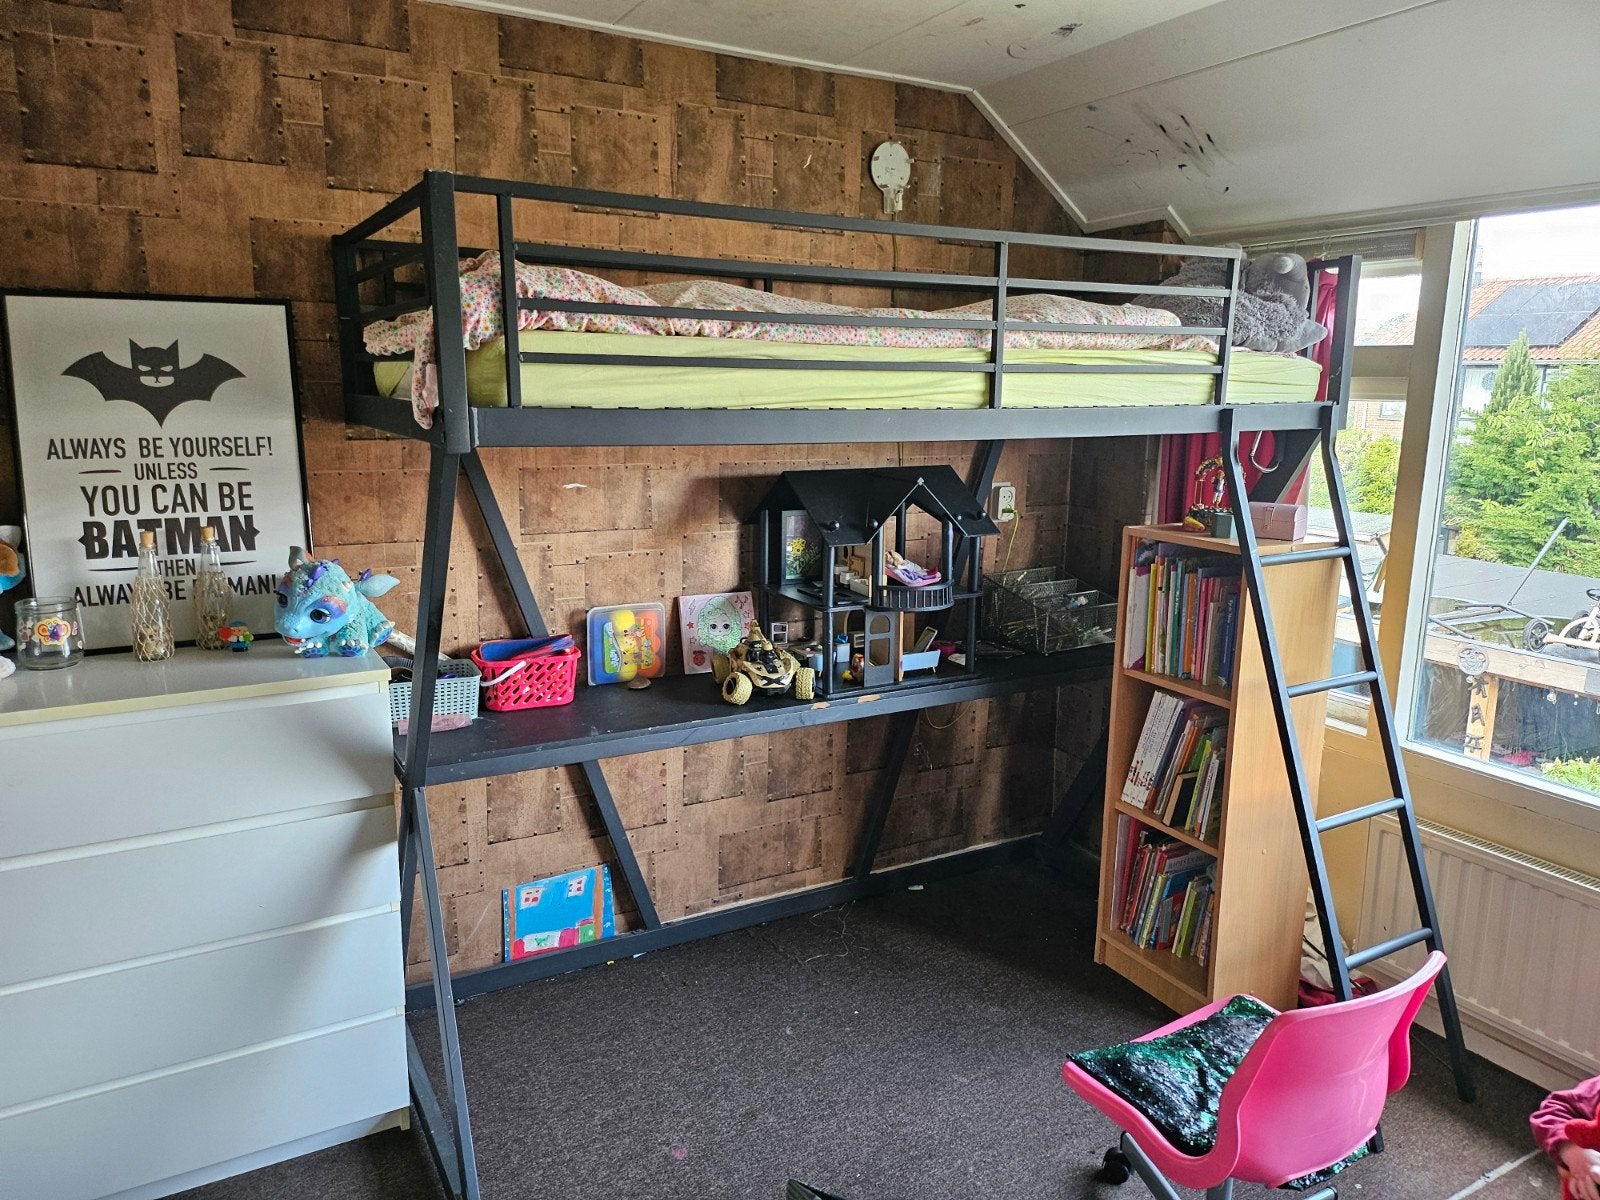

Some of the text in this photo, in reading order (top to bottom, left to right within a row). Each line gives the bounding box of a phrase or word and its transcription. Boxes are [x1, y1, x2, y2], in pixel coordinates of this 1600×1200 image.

[47, 436, 273, 460] ALWAYS BE YOURSELF!
[134, 462, 198, 480] UNLESS
[80, 482, 254, 517] YOU CAN BE
[79, 514, 259, 560] BATMAN
[157, 558, 196, 577] THEN
[74, 583, 134, 607] ALWA
